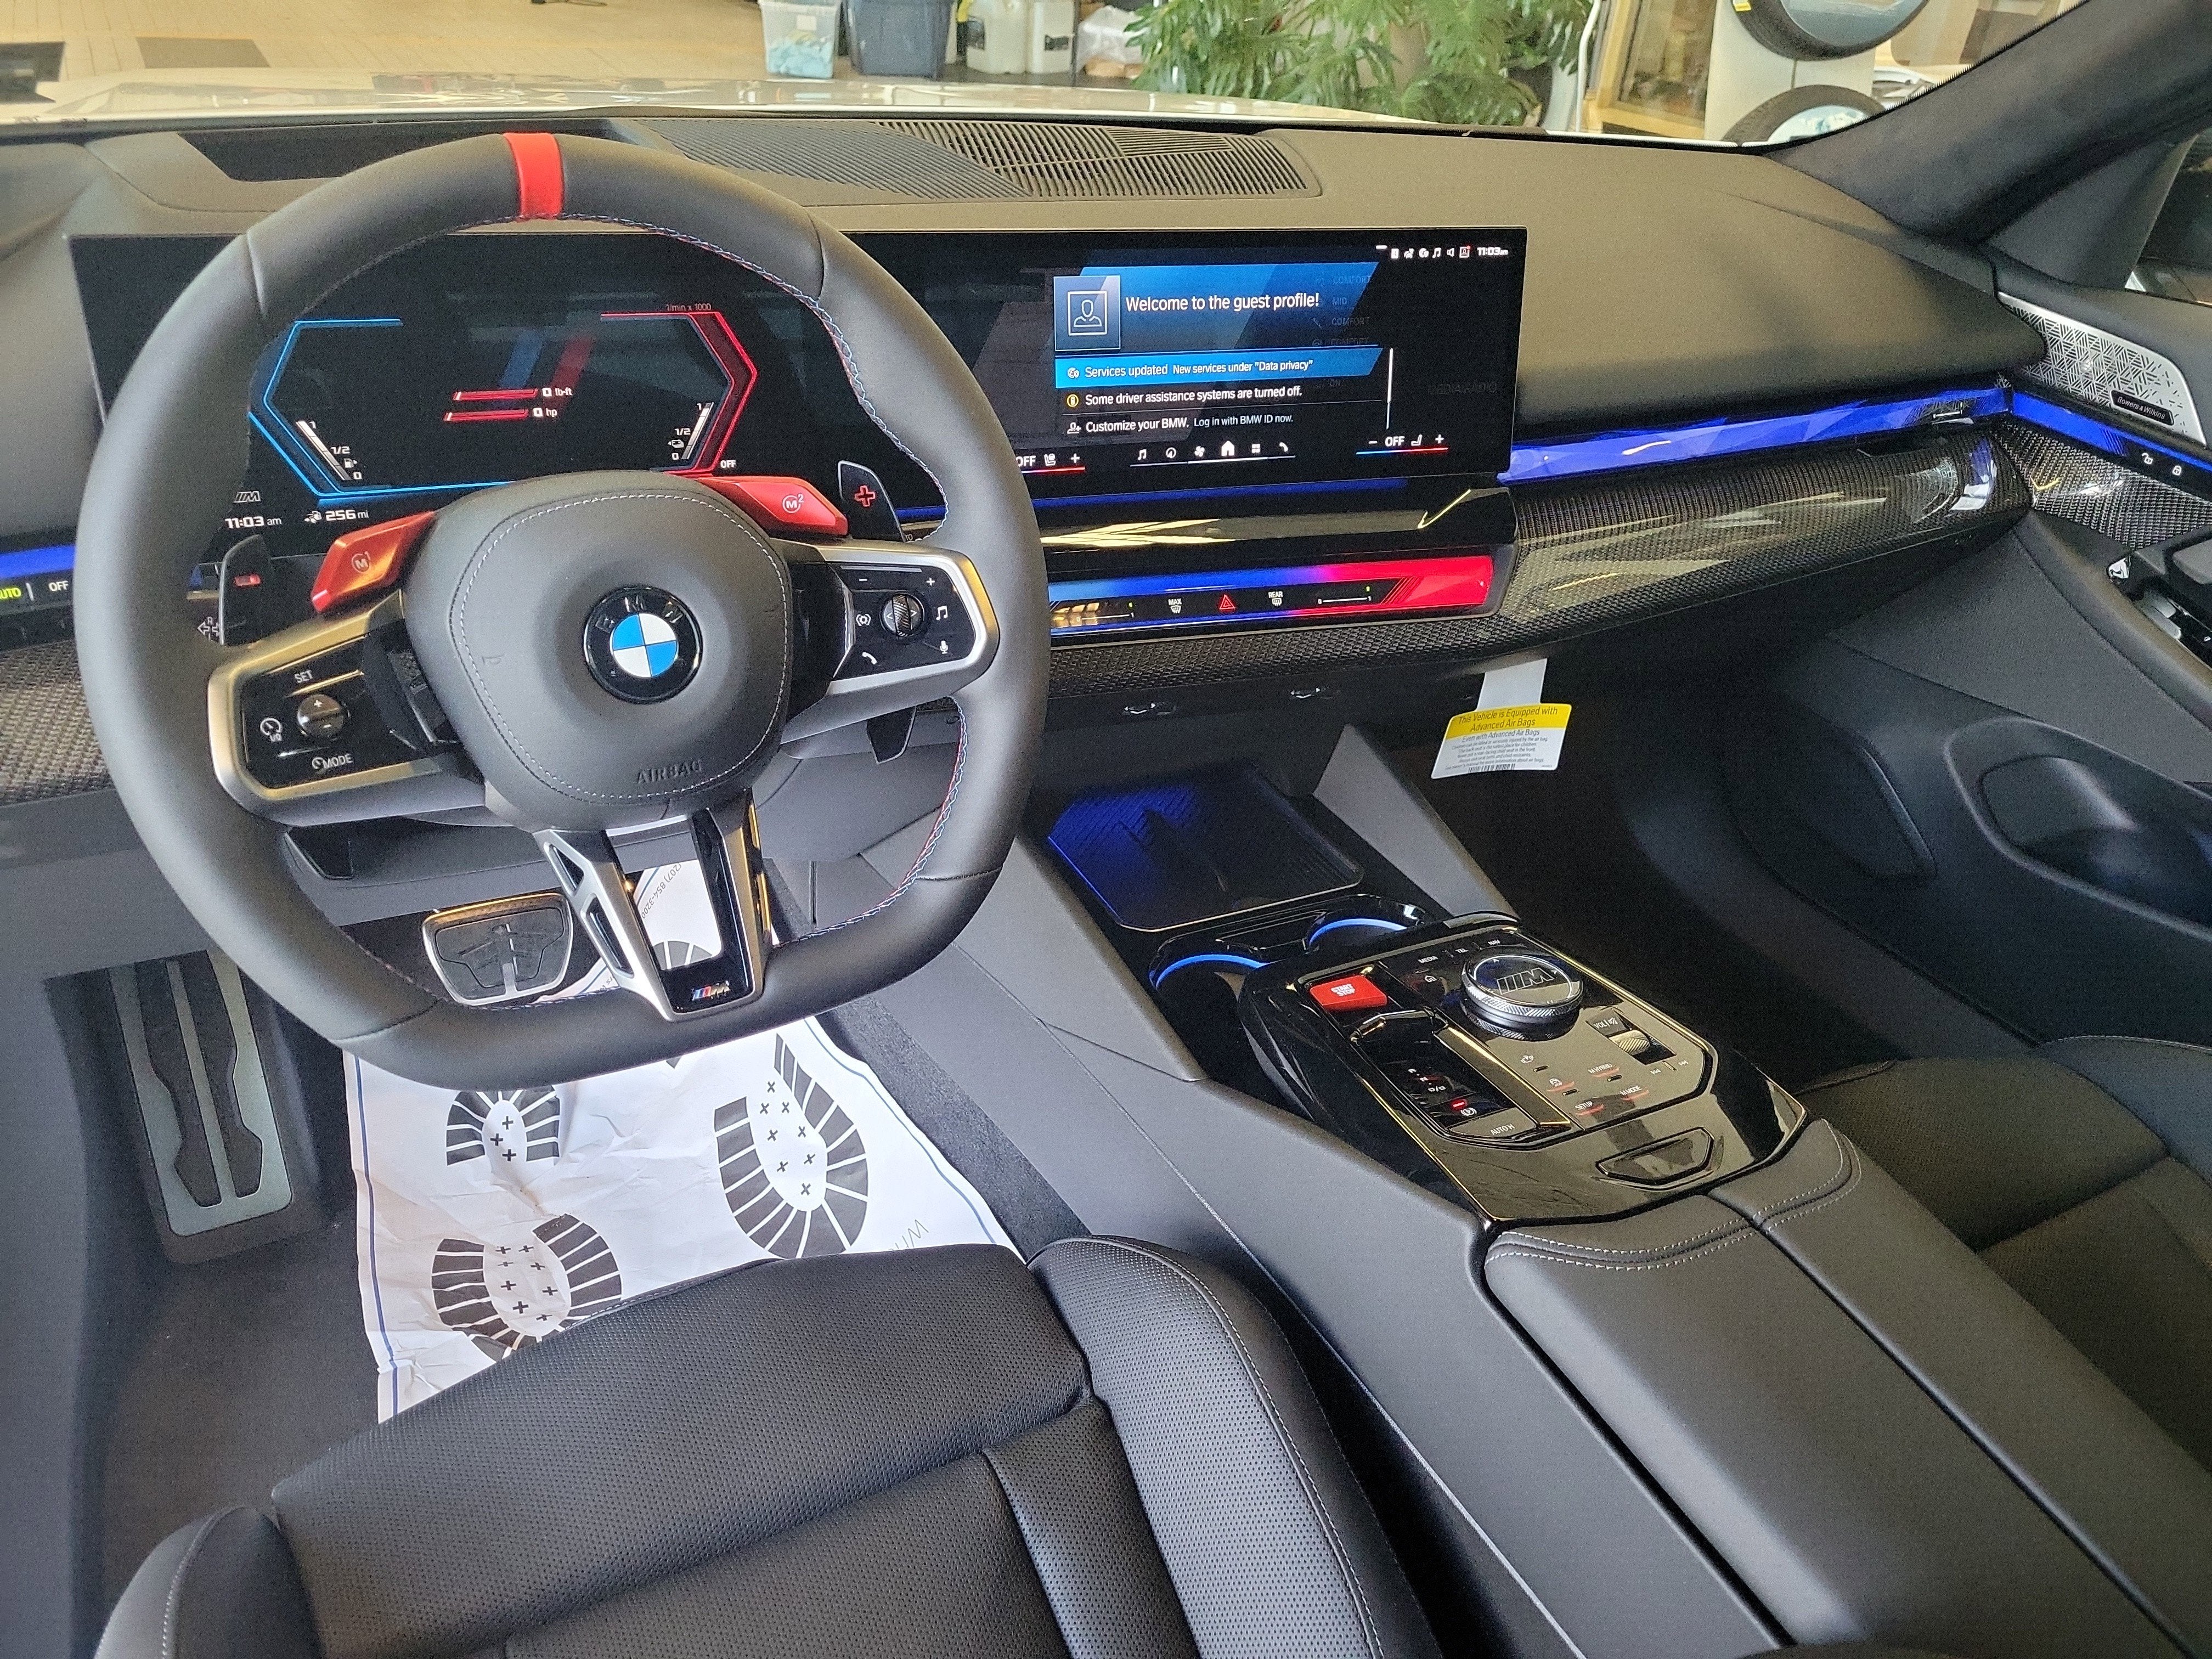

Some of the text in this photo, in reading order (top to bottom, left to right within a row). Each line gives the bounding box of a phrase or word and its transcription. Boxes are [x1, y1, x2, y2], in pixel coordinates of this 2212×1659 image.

[694, 303, 712, 311] 1000
[1125, 293, 1319, 312] Welcome to the guest profile!
[1085, 359, 1313, 378] Services updated New services under "Data privacy"
[555, 387, 573, 396] lb-ft
[1085, 394, 1114, 405] Some
[1116, 392, 1144, 404] driver
[1145, 391, 1195, 403] assistance
[1197, 389, 1235, 402] systems
[1237, 390, 1252, 398] are
[1254, 386, 1285, 398] turned
[1287, 385, 1302, 397] off.
[545, 408, 558, 417] hp
[2117, 397, 2140, 410] Bowers
[2143, 406, 2165, 420] Wilkins
[309, 421, 317, 429] 1
[1086, 414, 1294, 432] Customize your BMW. Log in with BMW ID now.
[1385, 436, 1405, 447] OFF
[330, 446, 351, 454] 1/2
[720, 460, 736, 468] OFF
[325, 509, 369, 521] 256 mi
[225, 516, 283, 528] 11:03 am
[48, 580, 69, 592] OFF
[1167, 597, 1182, 606] MAX
[294, 669, 313, 683] SET
[1459, 715, 1471, 724] This
[1473, 712, 1497, 721] Vehicle
[1506, 707, 1541, 718] Equipped
[1541, 706, 1558, 714] with
[1470, 720, 1504, 731] Advanced
[1517, 718, 1536, 728] Bags
[1488, 730, 1515, 738] Advanced
[1525, 729, 1540, 737] Bags
[323, 753, 353, 769] MODE
[637, 759, 702, 784] AIRBAG
[641, 862, 682, 919] (207) 854-3200
[1330, 983, 1353, 993] START
[1336, 988, 1356, 997] STOP
[1593, 1020, 1607, 1030] VOL
[1575, 1101, 1593, 1111] SETUP
[1490, 1122, 1515, 1136] AUTO H
